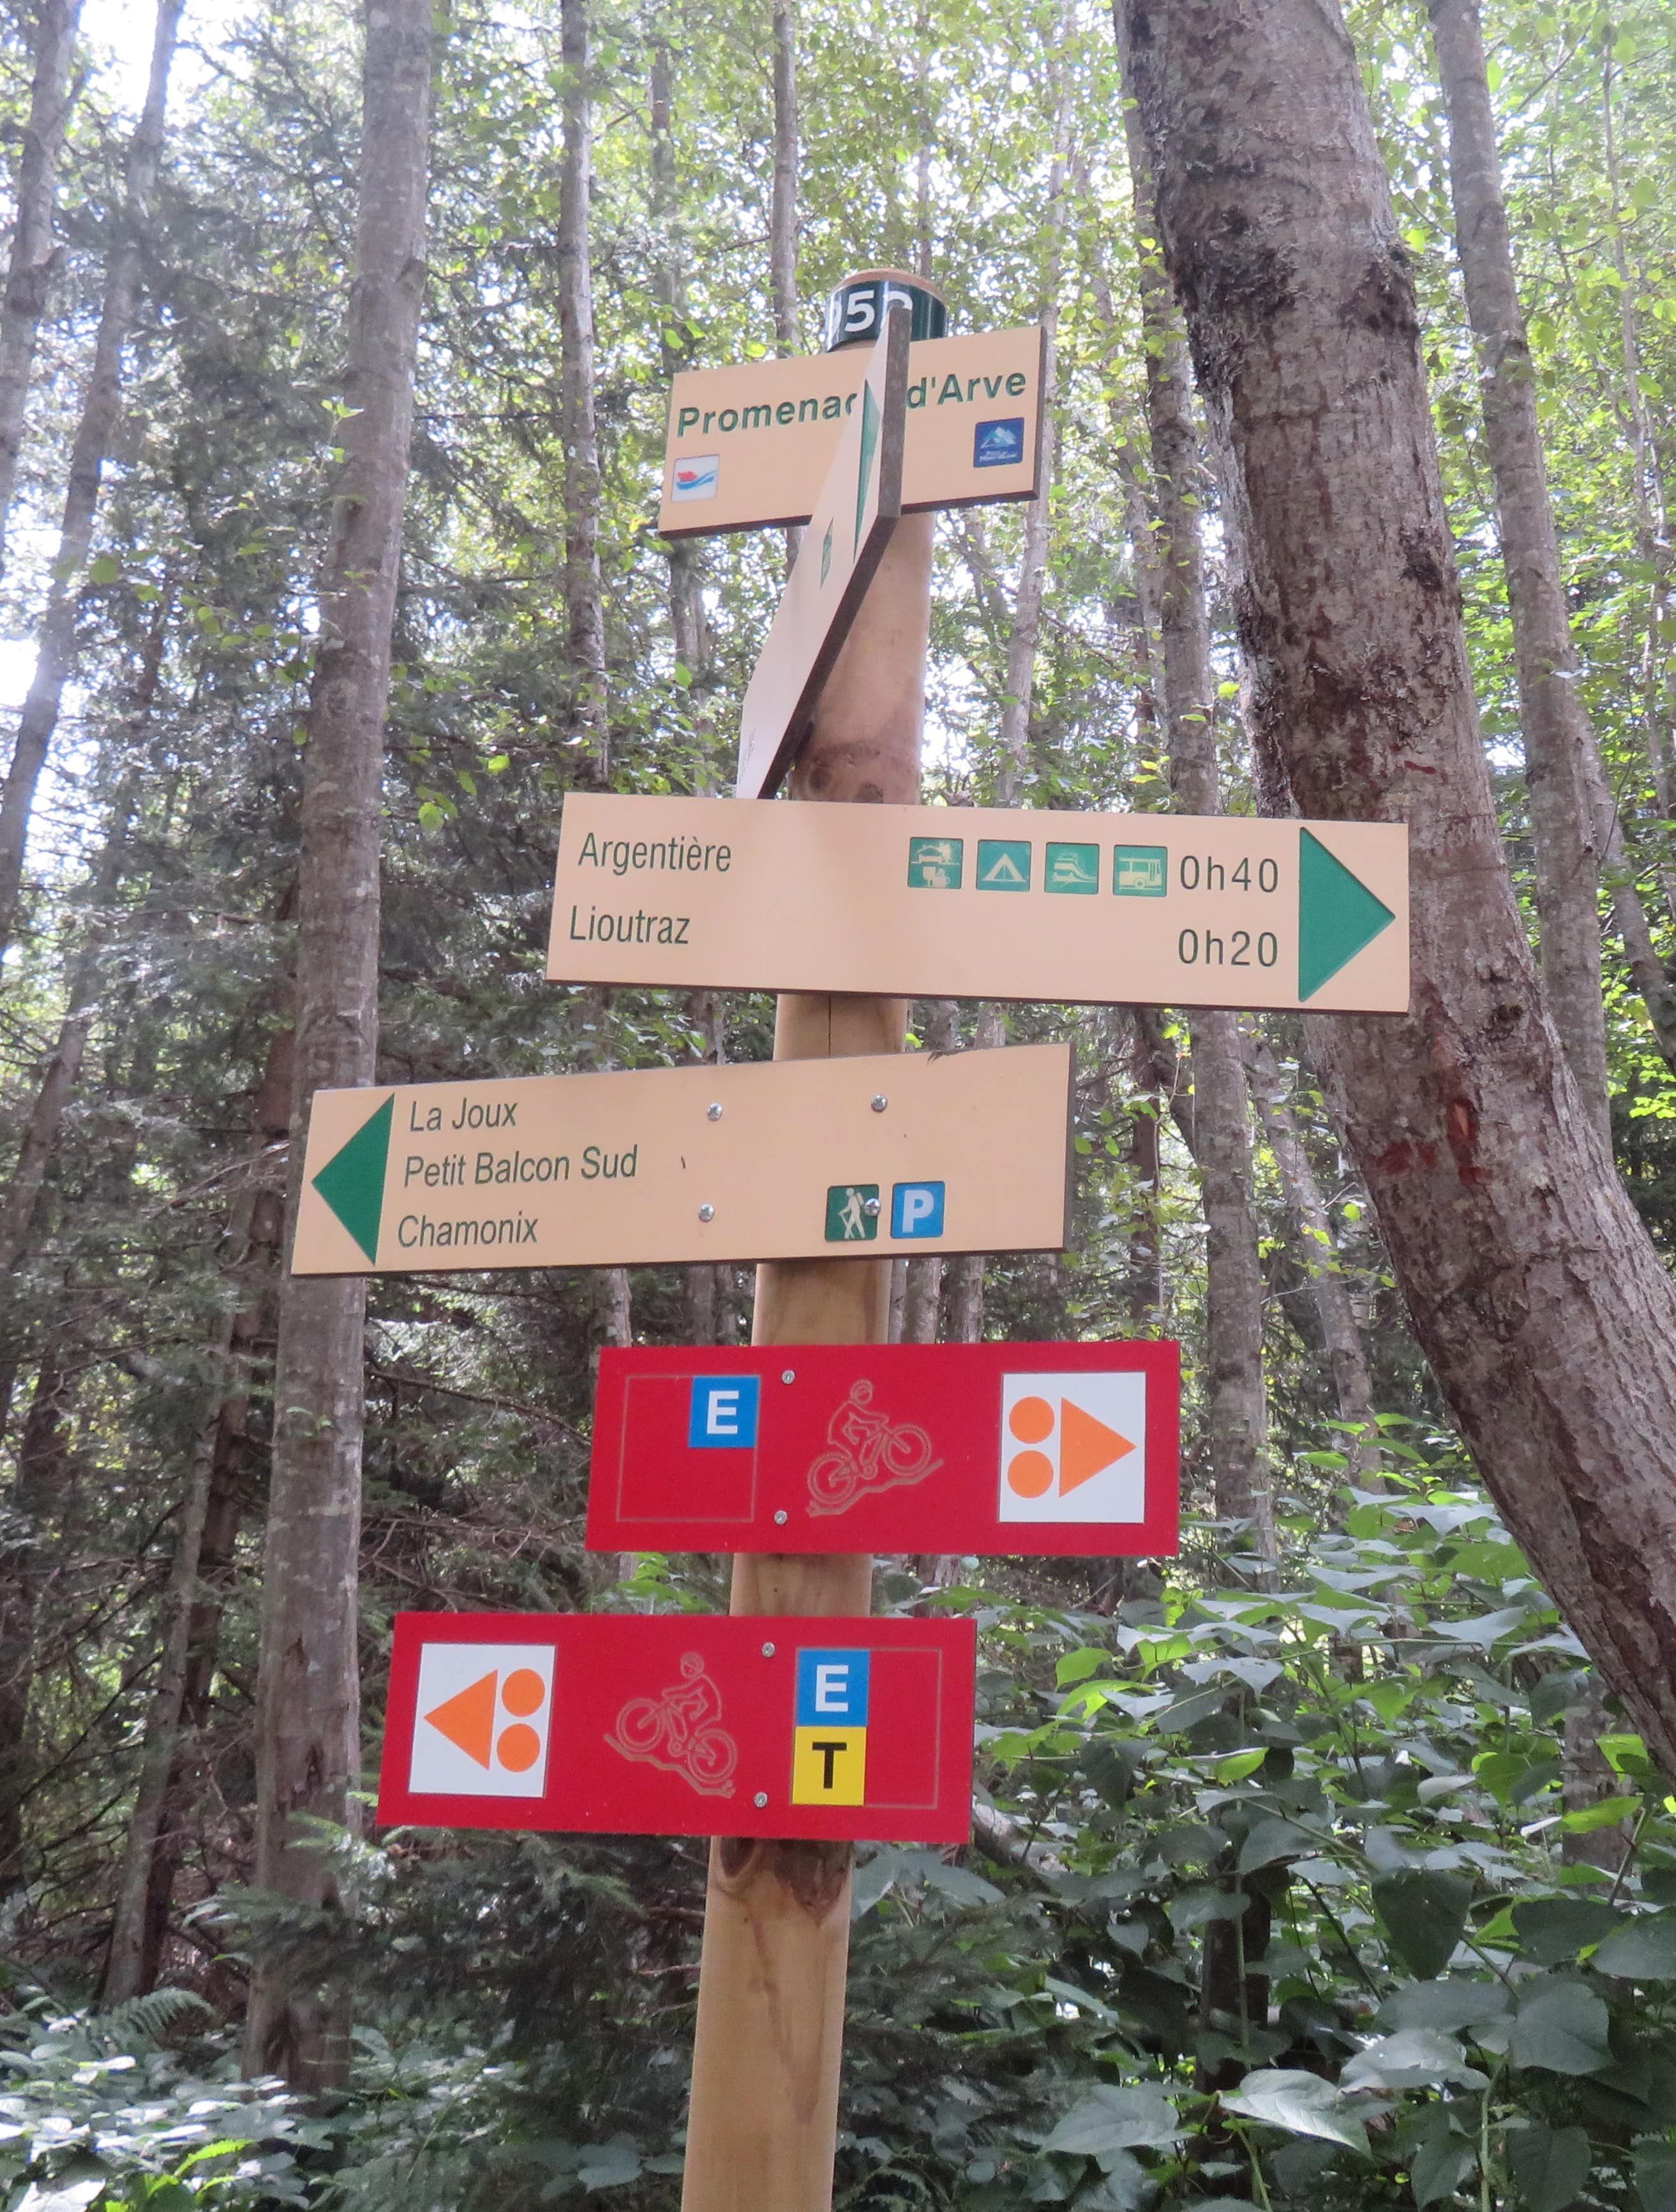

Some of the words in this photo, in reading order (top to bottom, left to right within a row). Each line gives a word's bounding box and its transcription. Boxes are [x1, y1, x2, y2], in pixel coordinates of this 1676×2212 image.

[677, 392, 858, 438] Promena
[905, 371, 1026, 410] d'Arve
[578, 832, 732, 876] Argentière
[1180, 855, 1278, 893] 0h40
[569, 904, 691, 945] Lioutraz
[1178, 928, 1278, 968] 0h20
[409, 1100, 442, 1132] La
[451, 1097, 519, 1130] Joux
[403, 1153, 467, 1188] Petit
[474, 1151, 570, 1185] Balcon
[581, 1144, 638, 1179] Sud
[397, 1210, 539, 1248] Chamonix
[902, 1189, 934, 1234] P
[706, 1390, 740, 1435] E
[814, 1664, 849, 1713] E
[812, 1742, 848, 1790] T
